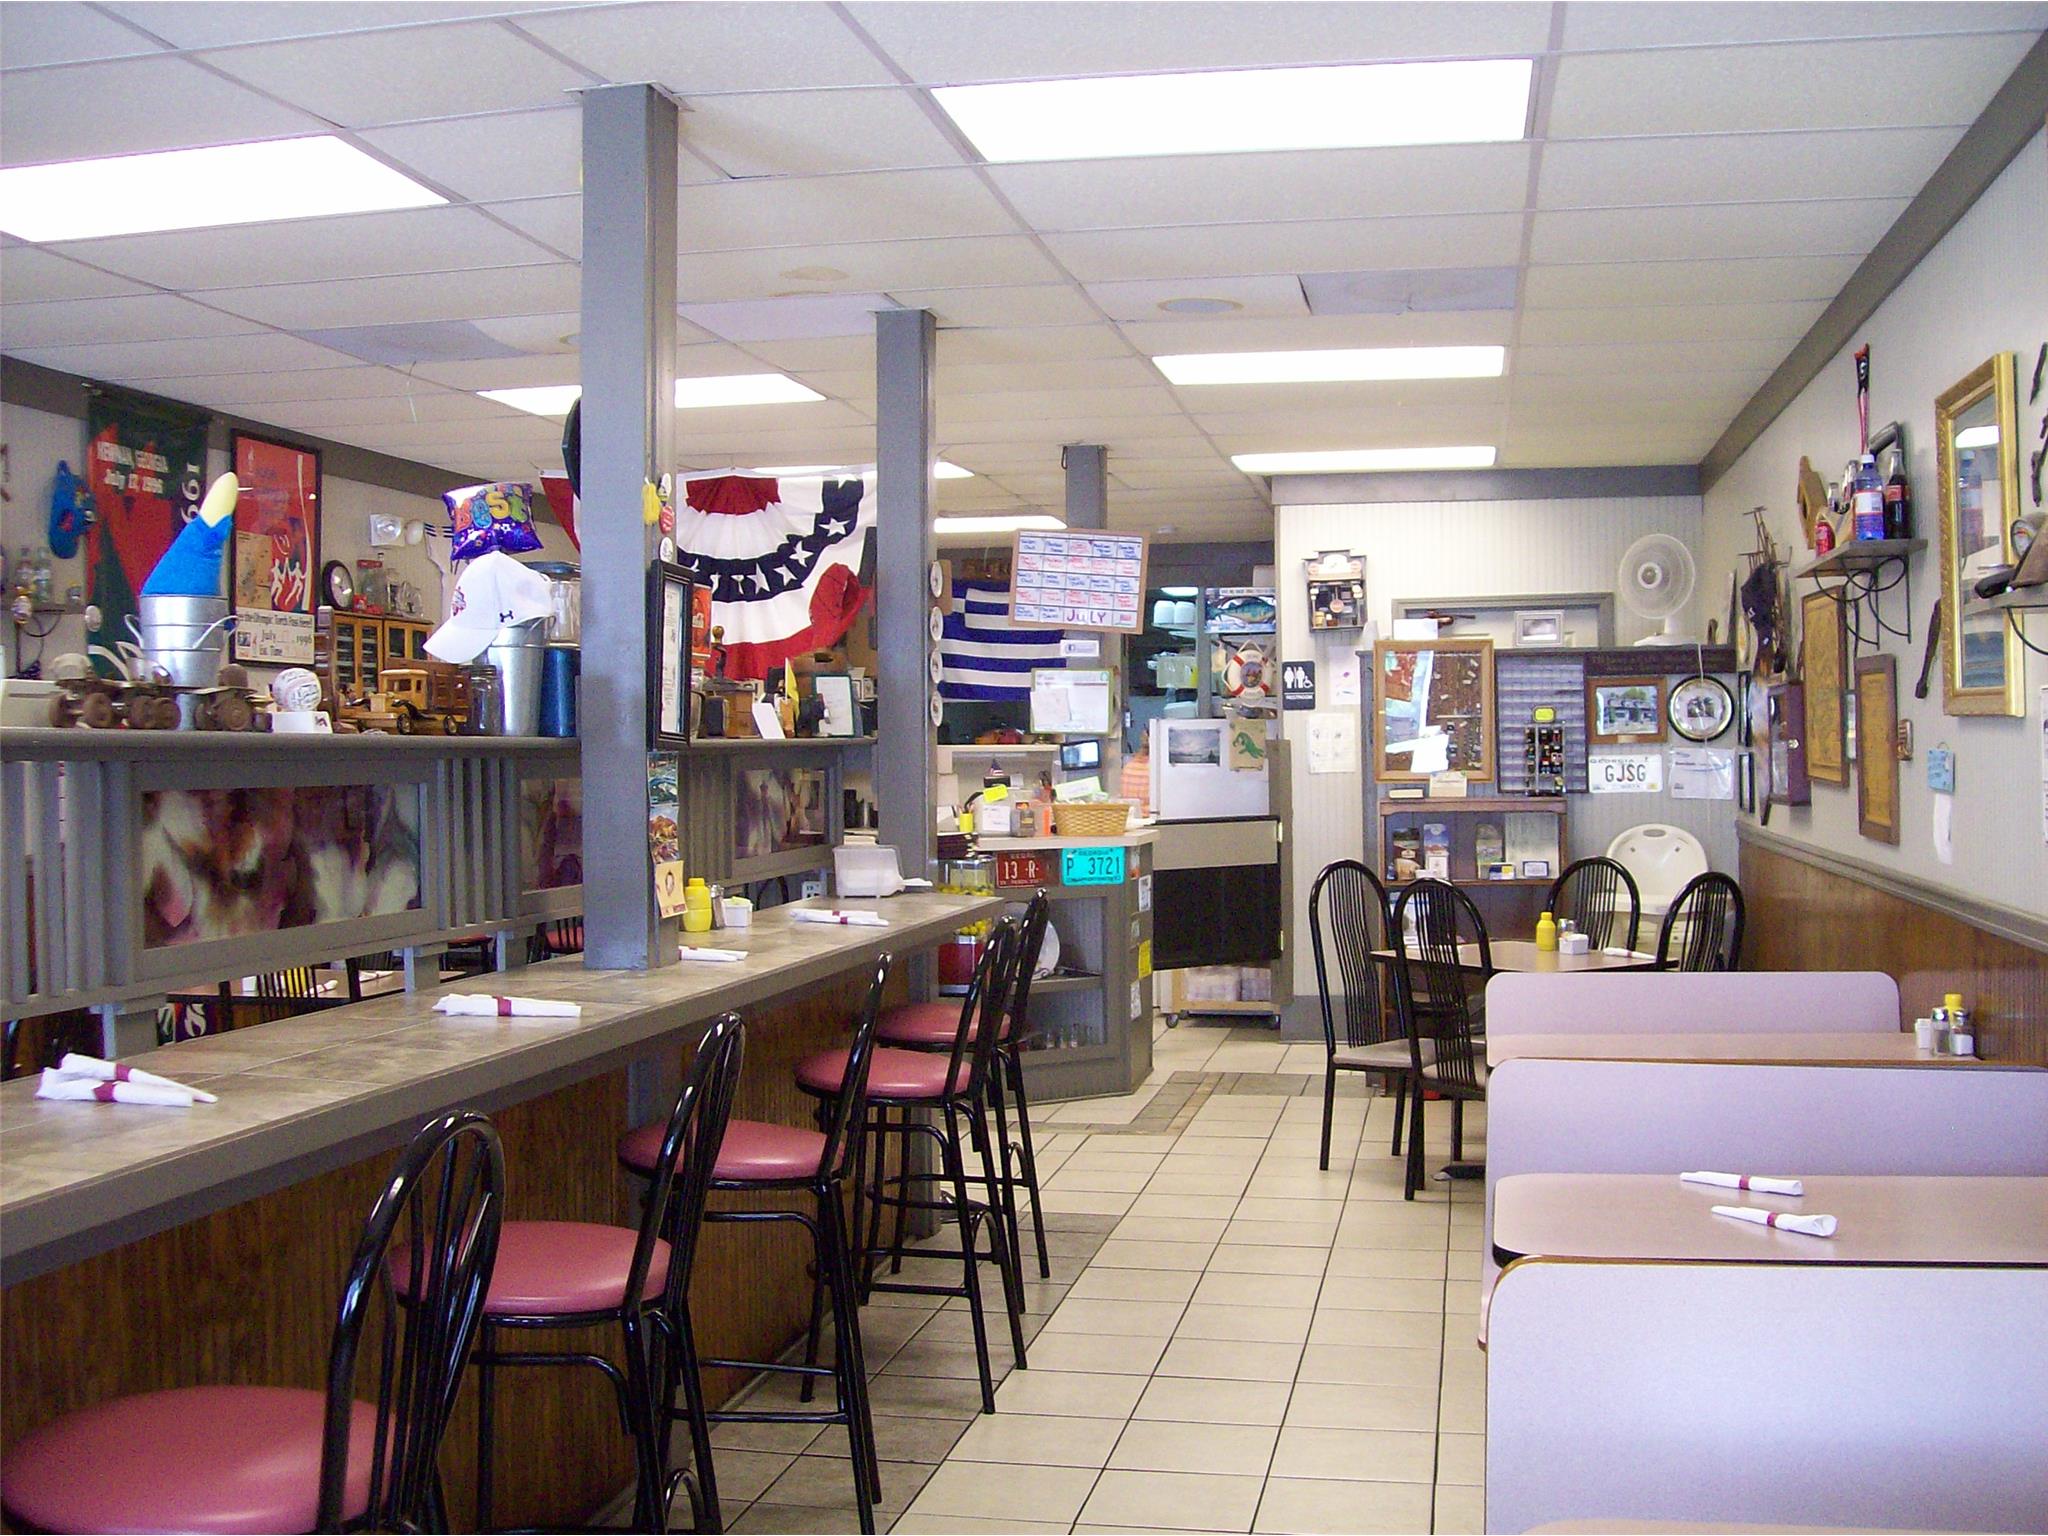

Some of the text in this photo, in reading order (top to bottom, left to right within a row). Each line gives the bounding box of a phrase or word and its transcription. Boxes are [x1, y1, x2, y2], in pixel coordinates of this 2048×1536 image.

[1605, 764, 1646, 782] GJSG
[1004, 861, 1018, 880] 13
[1066, 856, 1121, 876] P 3721
